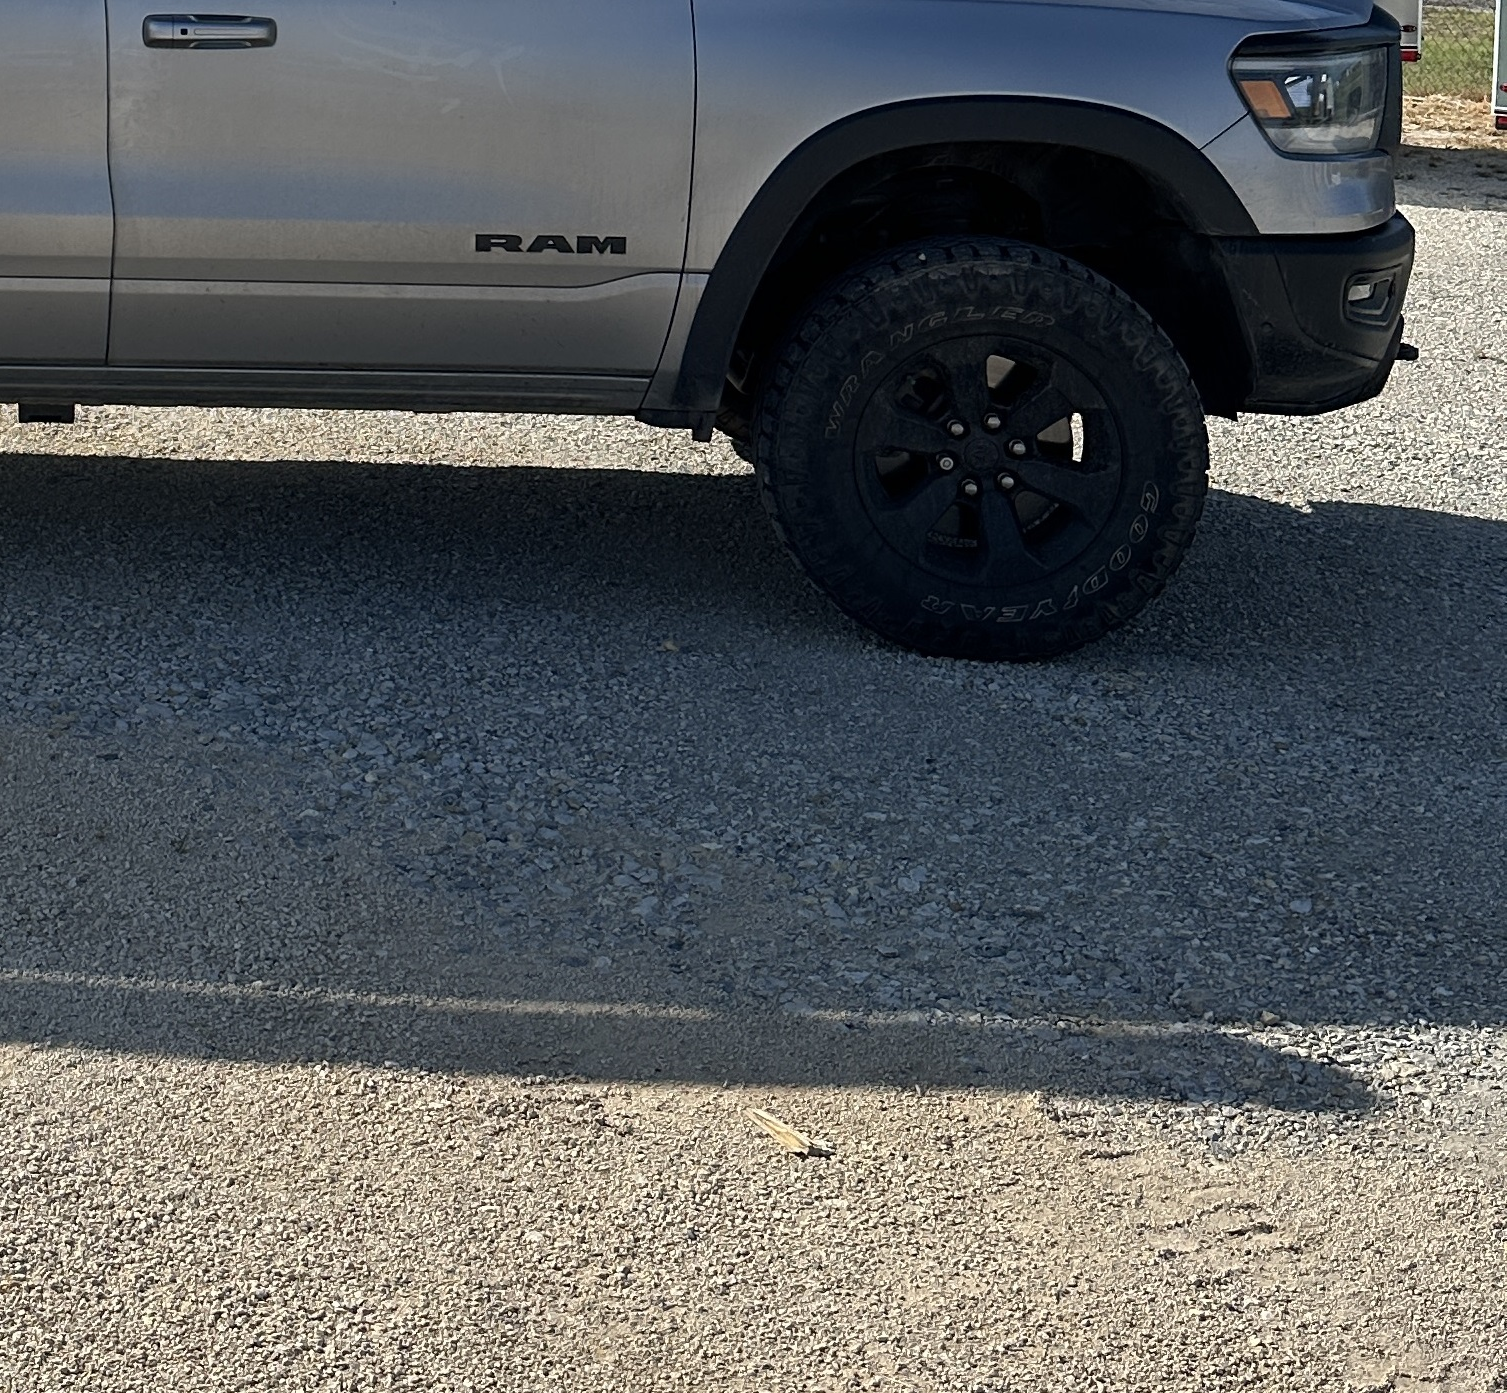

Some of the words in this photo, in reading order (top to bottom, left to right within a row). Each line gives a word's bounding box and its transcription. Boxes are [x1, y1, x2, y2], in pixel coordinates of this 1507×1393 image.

[475, 234, 627, 254] RAM
[825, 306, 1056, 439] WRANGLER
[920, 481, 1160, 623] GOODYEAR
